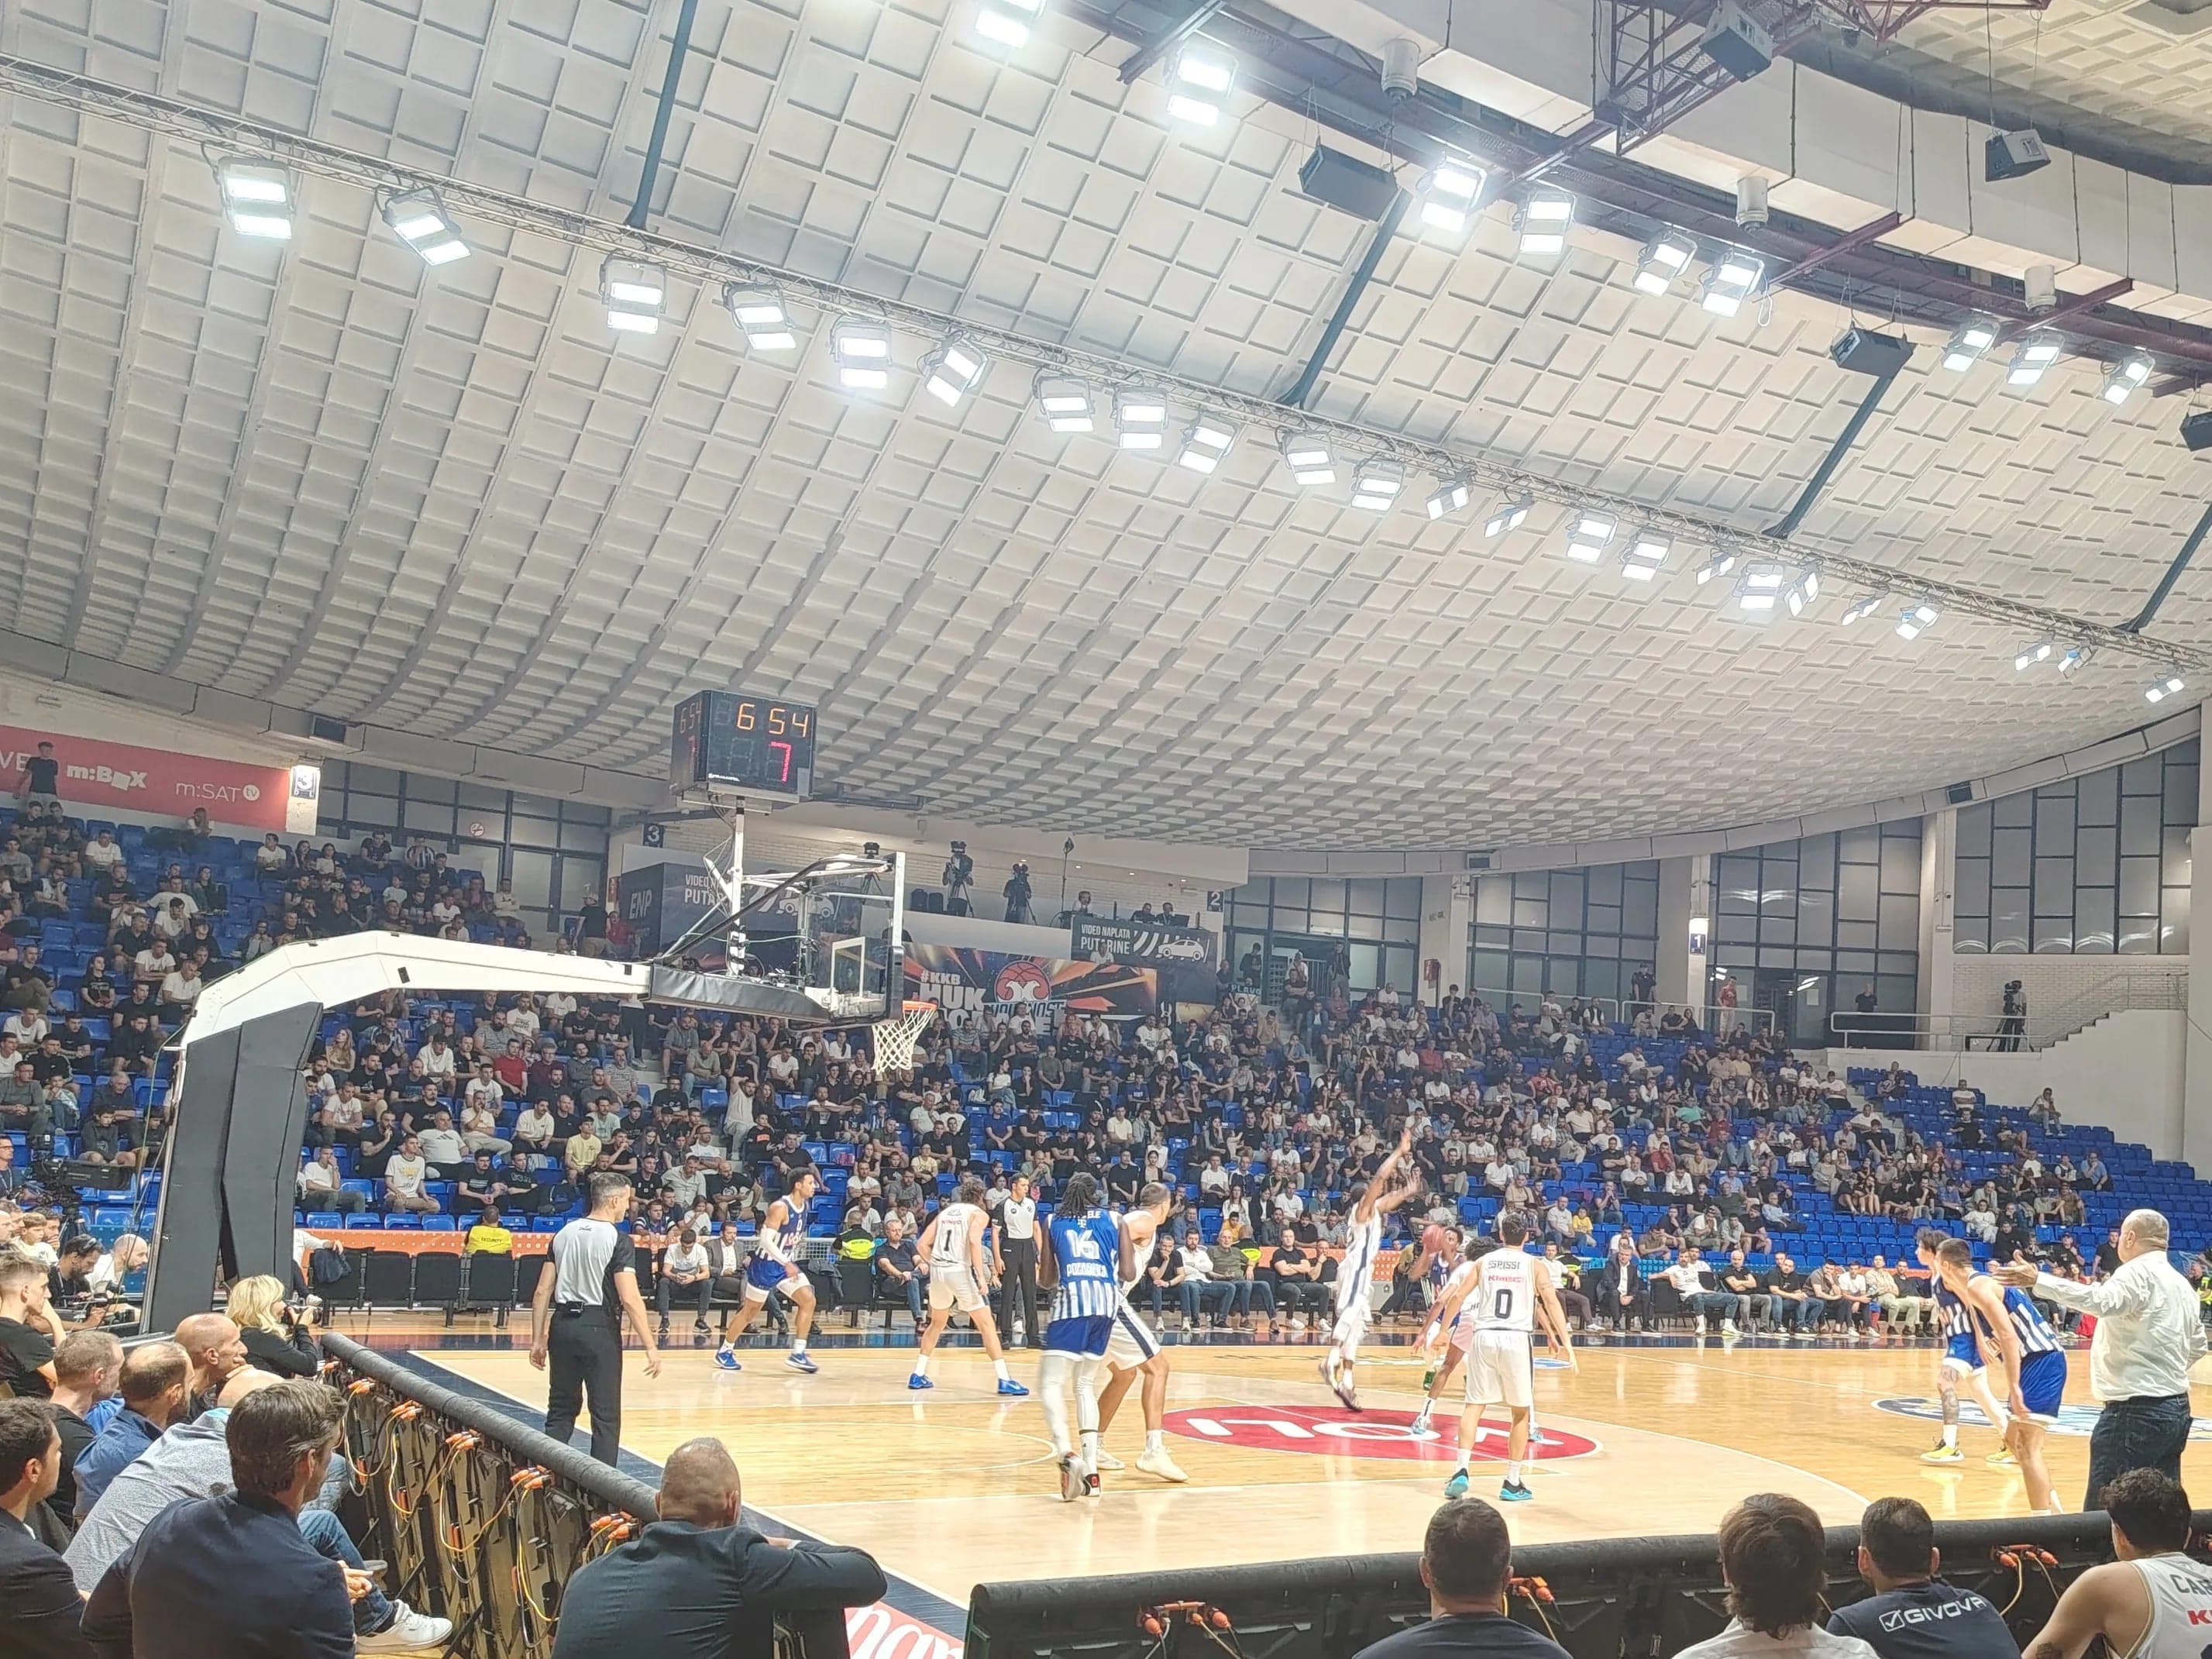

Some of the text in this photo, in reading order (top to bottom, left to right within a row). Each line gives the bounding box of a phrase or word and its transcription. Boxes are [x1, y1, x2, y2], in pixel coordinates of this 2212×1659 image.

[769, 741, 792, 783] 7
[647, 825, 660, 842] 3
[629, 889, 652, 920] ENP
[1210, 891, 1221, 907] 2
[1081, 923, 1131, 940] VIDEO NAPLATA
[1694, 934, 1701, 948] 1
[1080, 936, 1131, 955] PUTRINE
[943, 1229, 952, 1251] 1
[1066, 1229, 1100, 1261] 16
[1495, 1289, 1513, 1320] 0
[1904, 1596, 1987, 1624] GIVOVA
